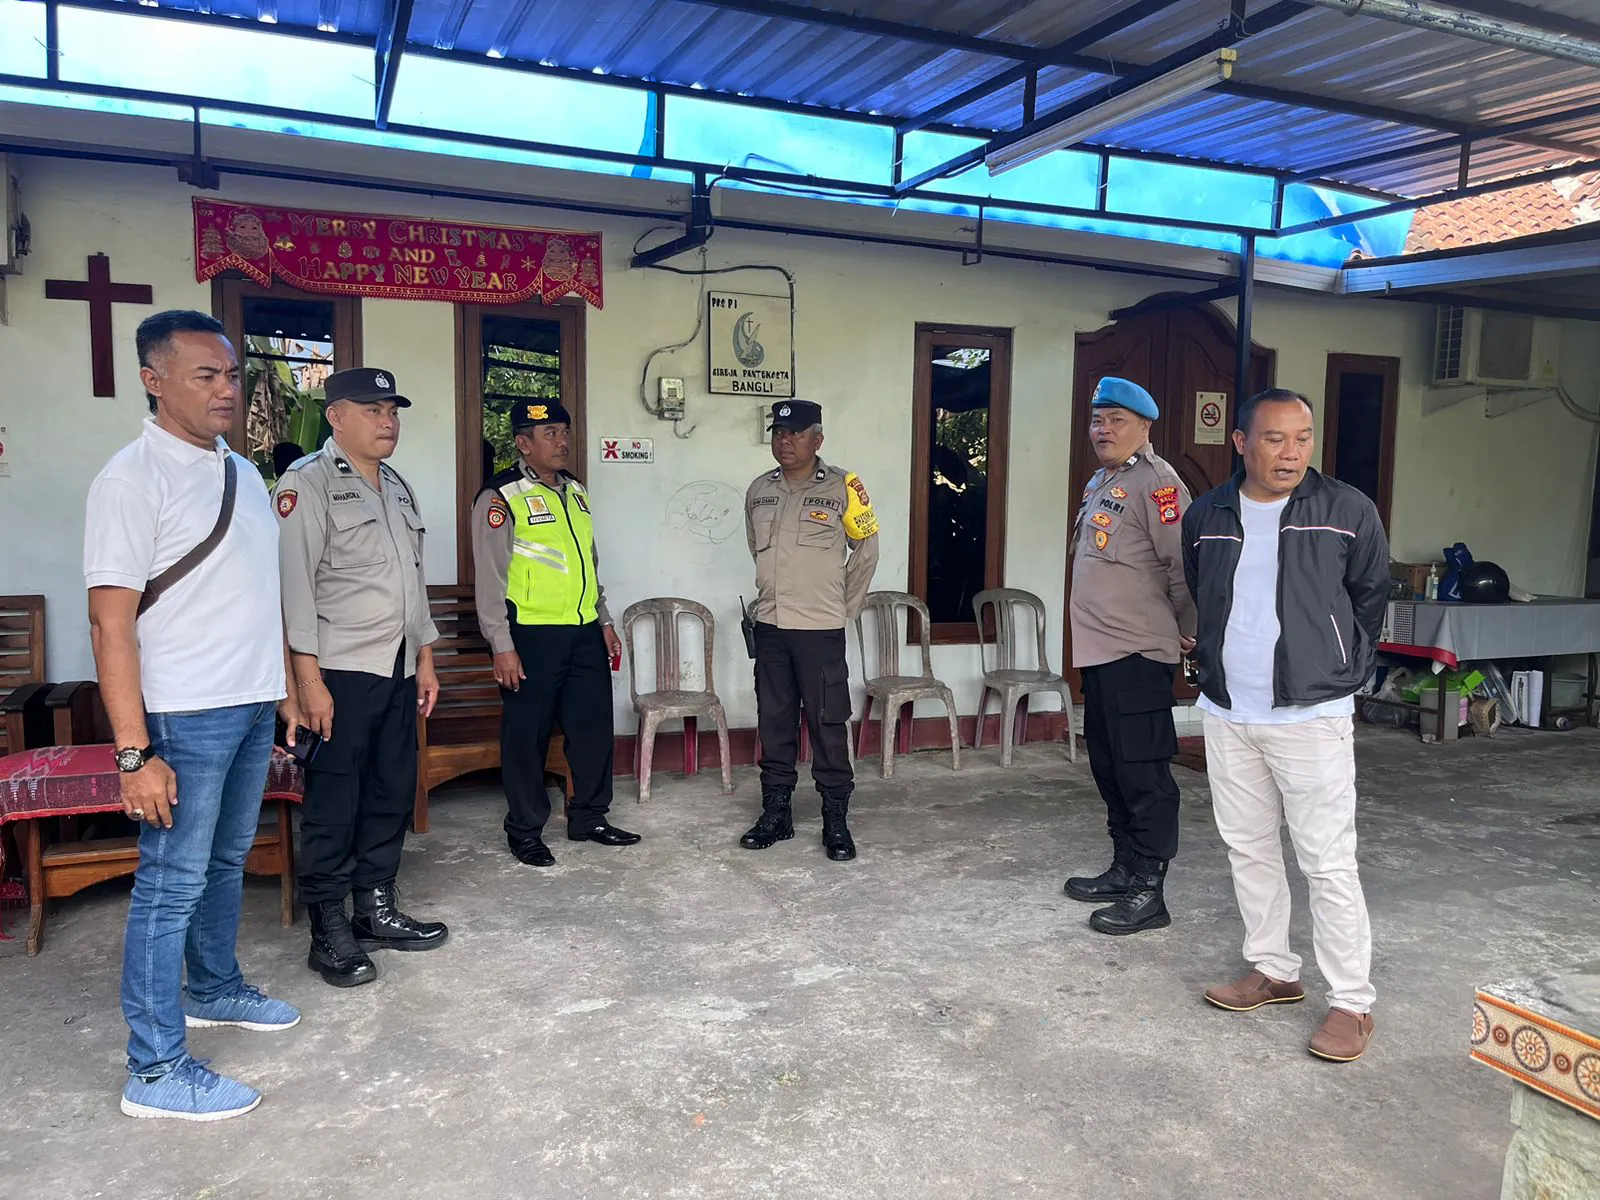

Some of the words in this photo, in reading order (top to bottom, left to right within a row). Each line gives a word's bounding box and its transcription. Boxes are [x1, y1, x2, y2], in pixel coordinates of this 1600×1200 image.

[288, 212, 377, 240] MERRY
[388, 220, 525, 251] CHRISTMAS
[388, 247, 436, 263] AND
[298, 256, 386, 283] HAPPY
[393, 264, 449, 286] NEW
[454, 266, 518, 291] YEAR
[732, 380, 773, 393] BANGLI
[632, 441, 641, 449] NO
[808, 498, 835, 507] POLRI
[1099, 498, 1125, 514] POLRI
